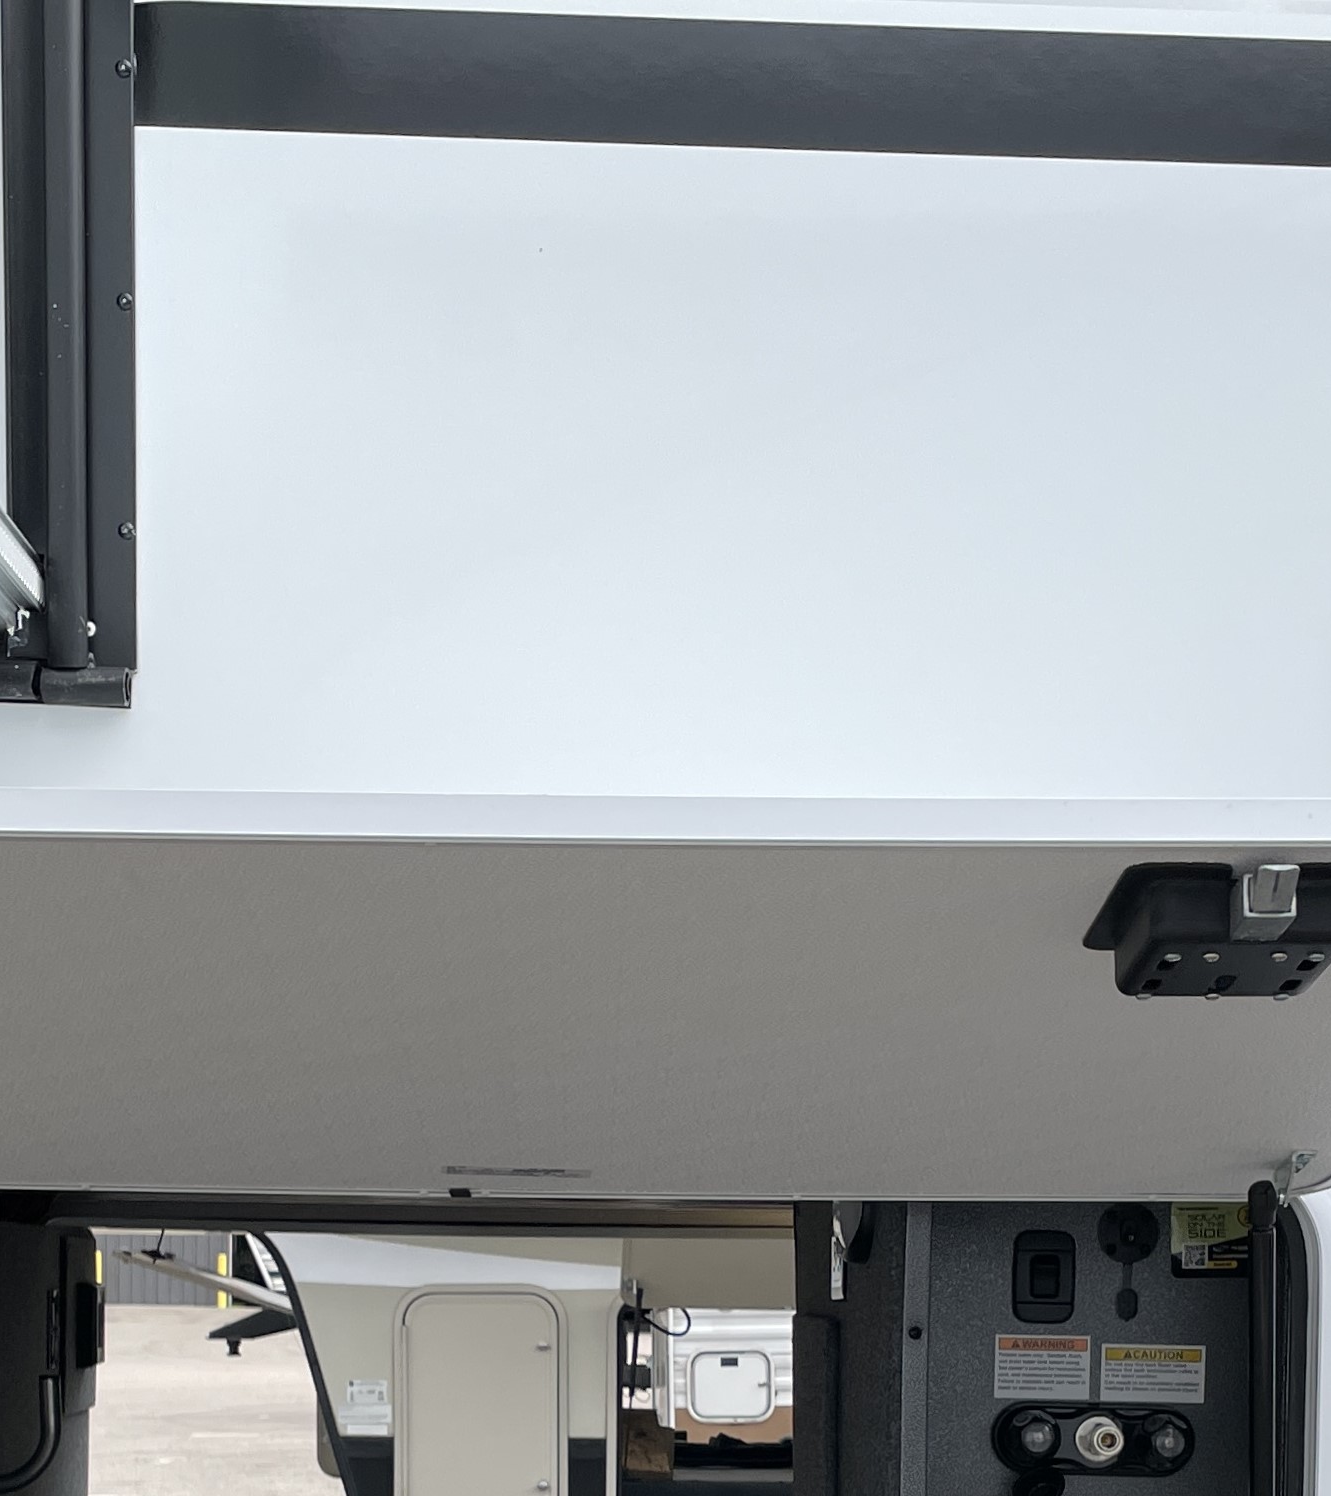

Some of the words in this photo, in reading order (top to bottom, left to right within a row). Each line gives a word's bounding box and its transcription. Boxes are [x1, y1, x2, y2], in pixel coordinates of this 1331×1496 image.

[1187, 1228, 1227, 1239] SIDE
[1022, 1338, 1075, 1349] WARNING
[1133, 1350, 1184, 1360] CAUTION
